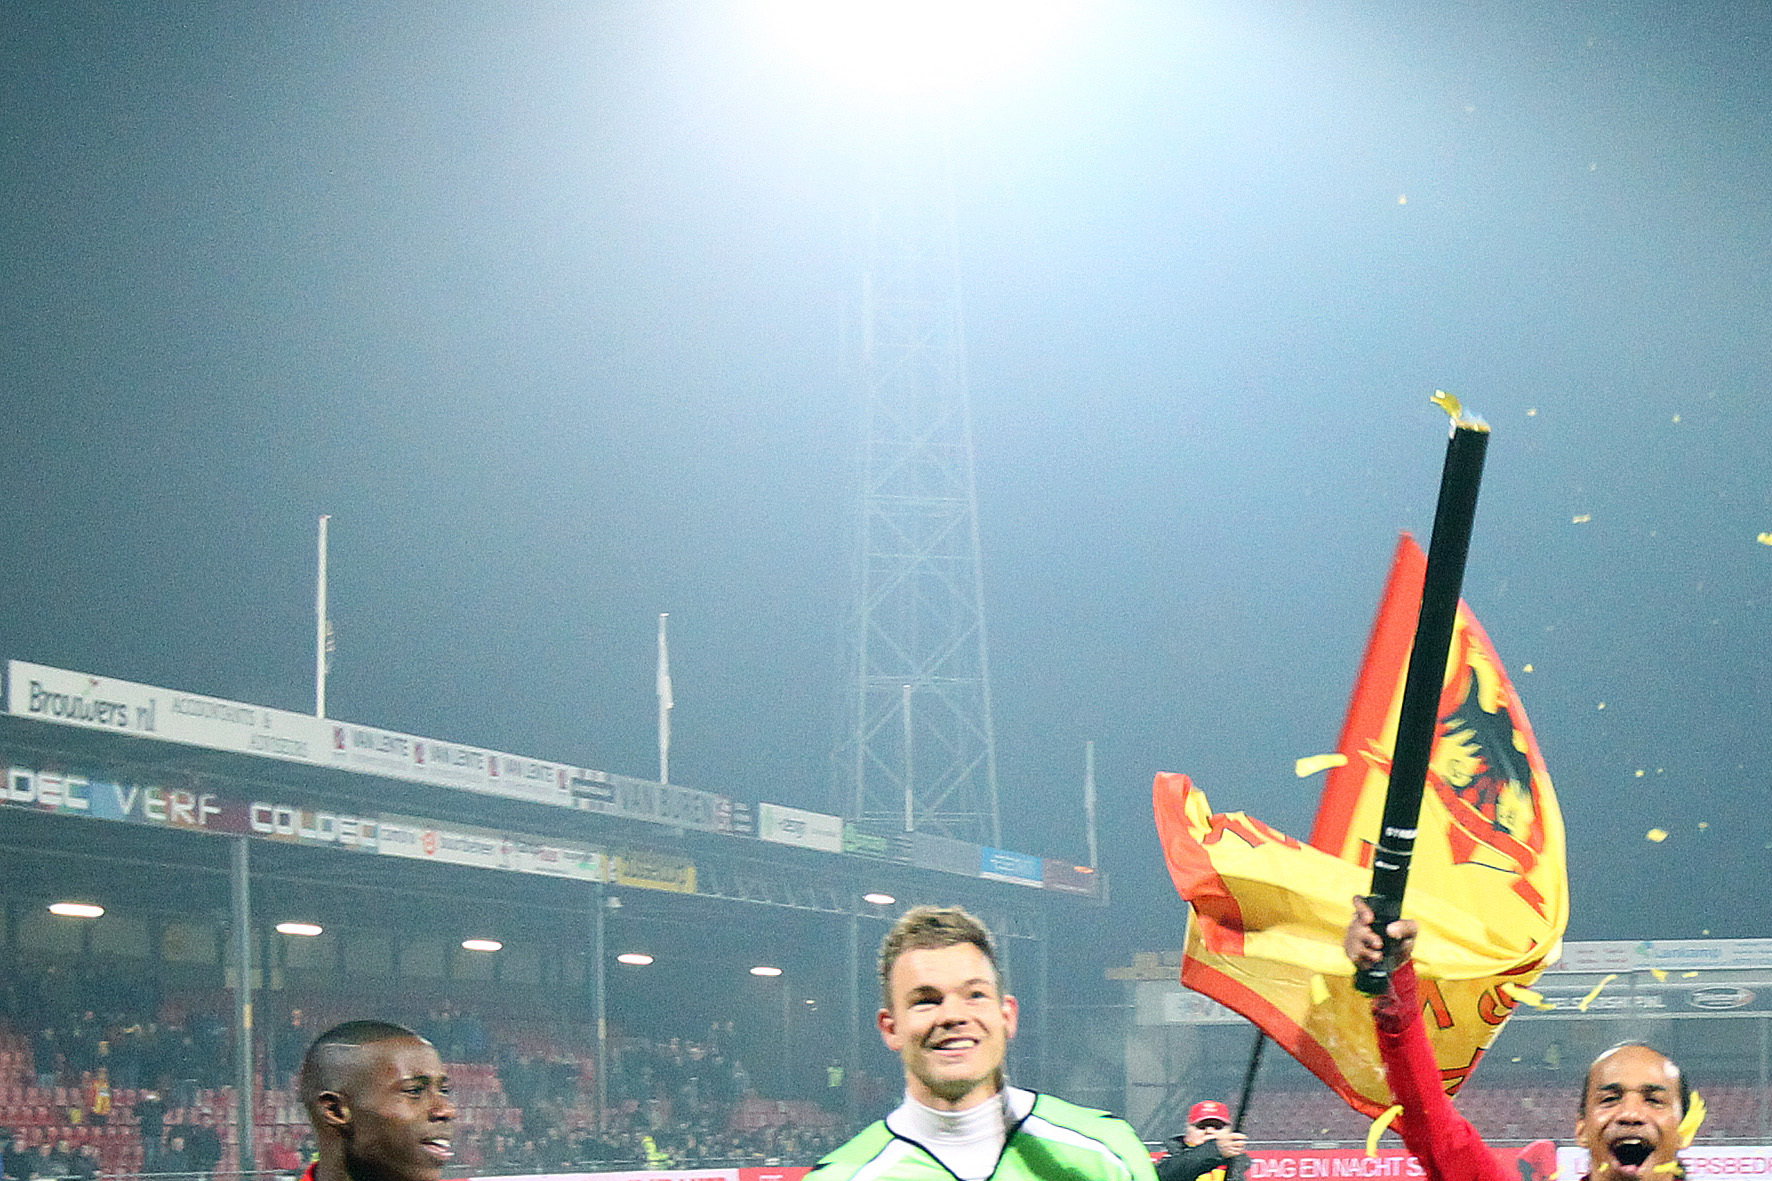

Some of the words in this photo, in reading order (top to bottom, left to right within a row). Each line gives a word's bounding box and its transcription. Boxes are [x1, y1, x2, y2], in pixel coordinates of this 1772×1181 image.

[115, 784, 222, 826] VERF
[1251, 1157, 1298, 1179] DAG
[1299, 1157, 1329, 1178] EN
[1332, 1156, 1404, 1178] NACHT
